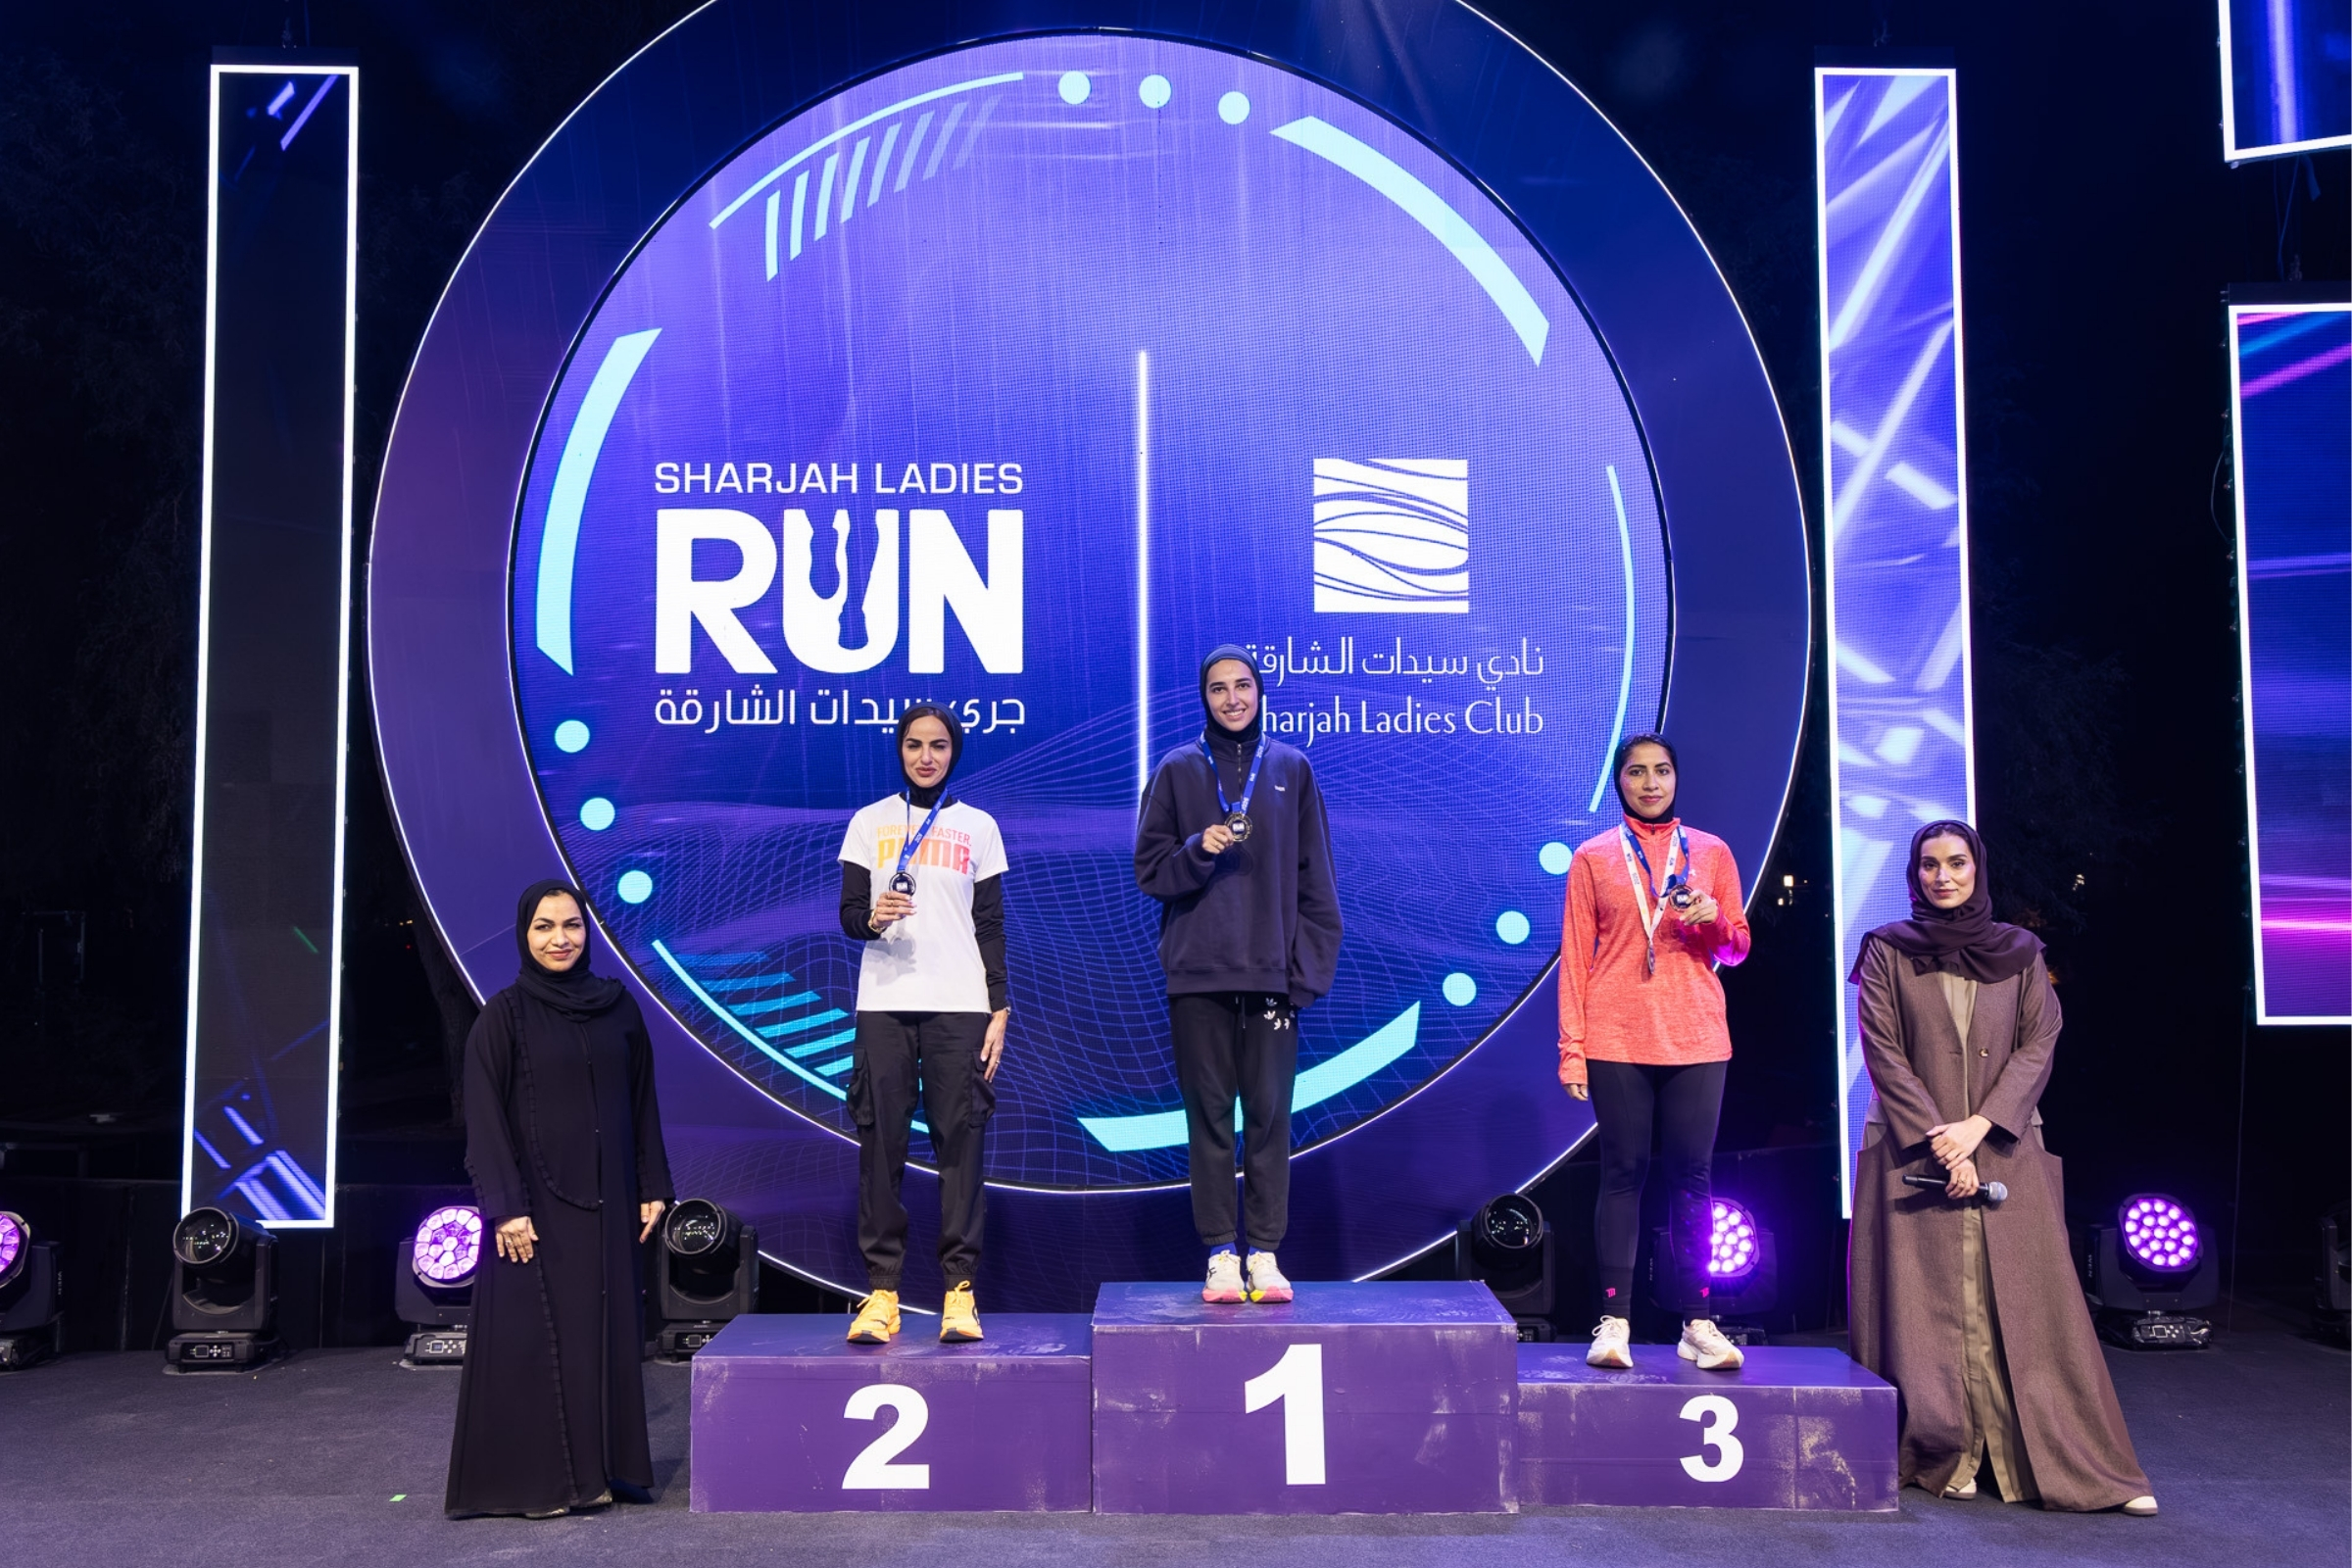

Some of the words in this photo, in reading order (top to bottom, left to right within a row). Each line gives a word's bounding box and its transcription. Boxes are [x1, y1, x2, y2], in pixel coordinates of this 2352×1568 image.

[655, 462, 858, 495] SHARJAH
[875, 462, 1024, 495] LADIES
[655, 508, 1023, 674] RUN
[1361, 636, 1468, 684] سيدات
[1477, 637, 1544, 692] نادي
[655, 684, 796, 734] الشارقة
[810, 689, 933, 734] يدات
[1261, 694, 1350, 748] harjah
[1361, 694, 1456, 734] Ladies
[1464, 694, 1544, 734] Club
[876, 824, 929, 839] FOREVE
[841, 1384, 930, 1490] 2
[1244, 1344, 1326, 1486] 1
[1679, 1395, 1744, 1483] 3
